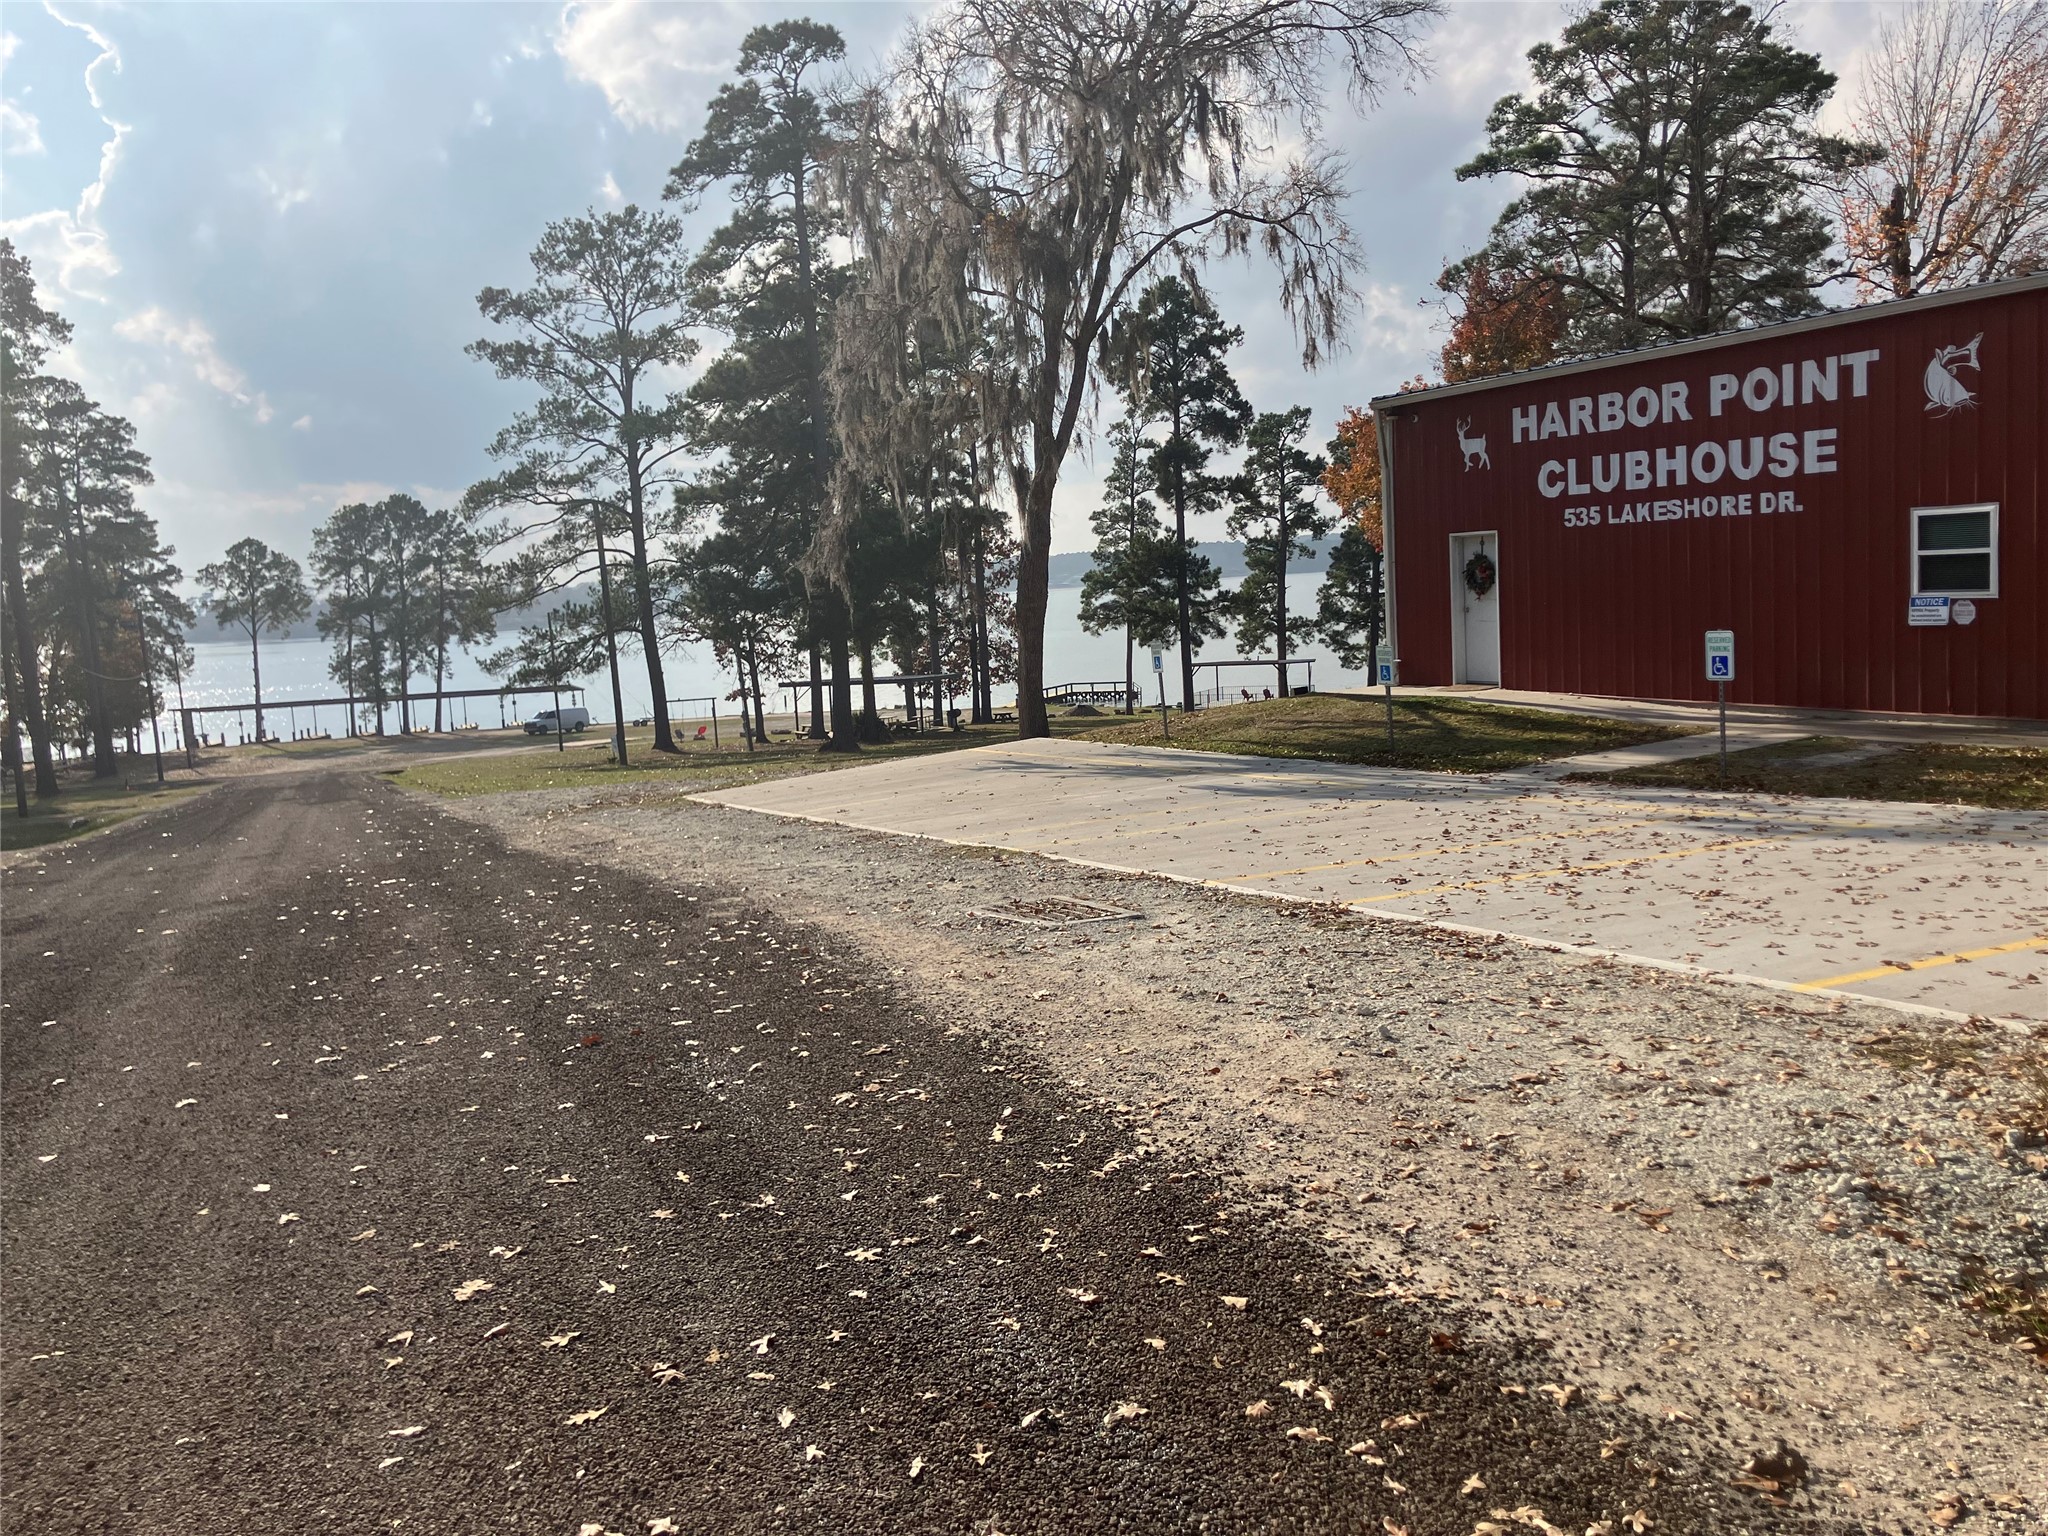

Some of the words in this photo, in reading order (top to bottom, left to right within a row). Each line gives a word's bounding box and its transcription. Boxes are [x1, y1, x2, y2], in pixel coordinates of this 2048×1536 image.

[1512, 381, 1692, 444] HARBOR
[1709, 349, 1880, 417] POINT
[1537, 428, 1838, 498] CLUBHOUSE
[1563, 506, 1601, 528] 535
[1607, 494, 1752, 524] LAKESHORE
[1760, 490, 1803, 514] DR.
[1914, 597, 1945, 606] NOTICE
